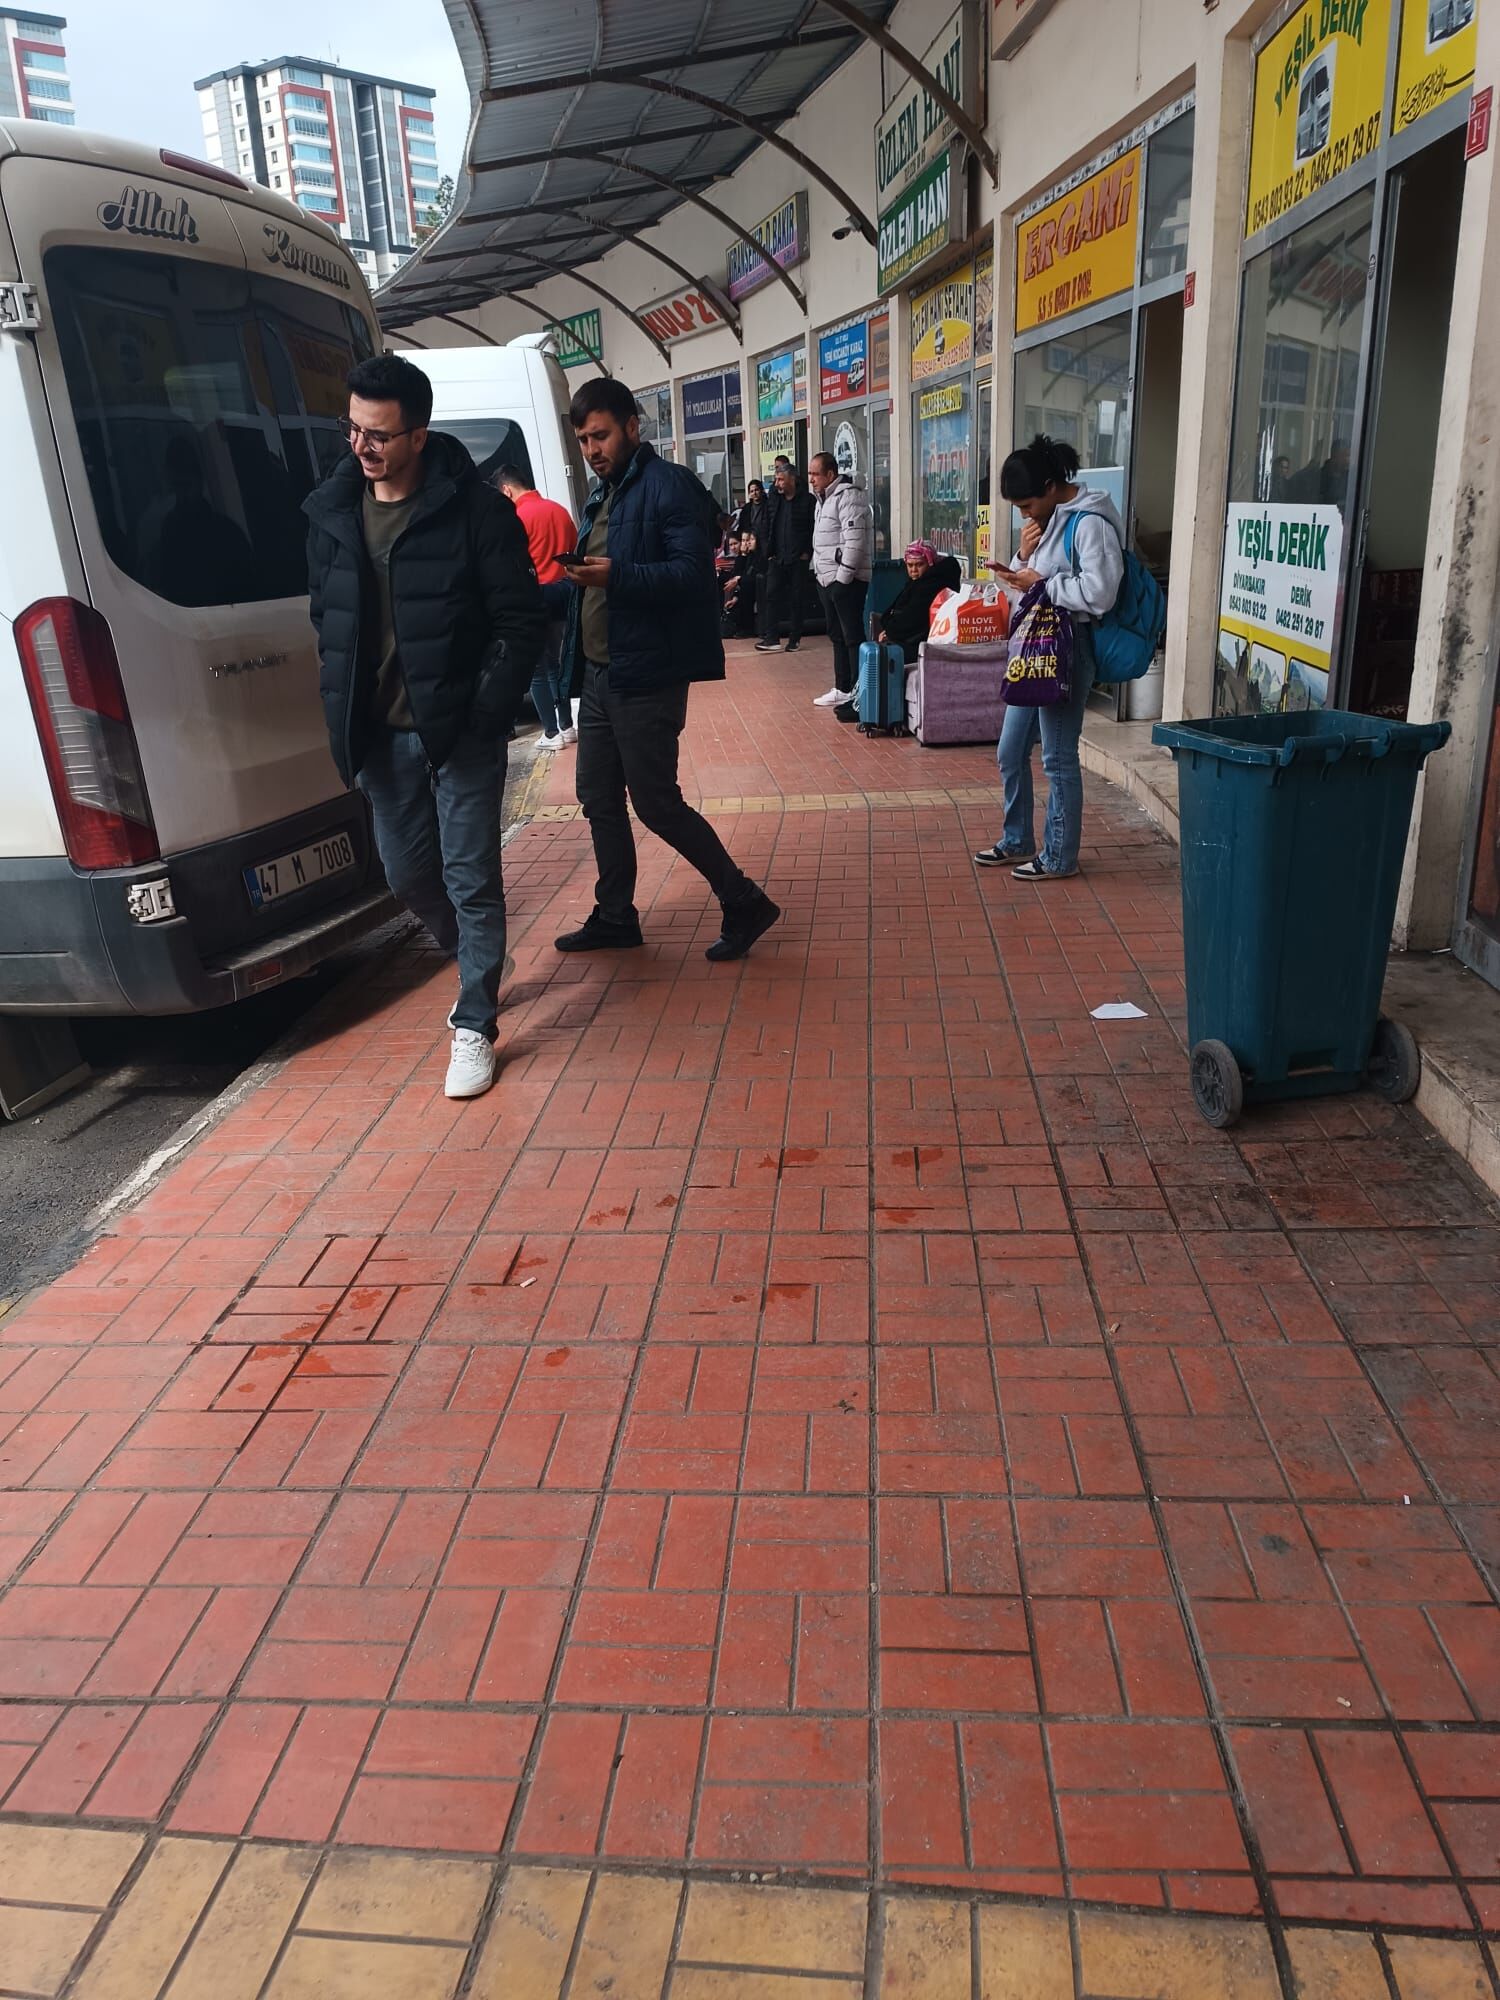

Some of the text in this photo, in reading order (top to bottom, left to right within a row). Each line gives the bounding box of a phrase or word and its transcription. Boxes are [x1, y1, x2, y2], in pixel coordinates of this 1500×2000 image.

[1274, 13, 1316, 118] YEŞİL
[878, 94, 918, 193] ÖZLEM
[1252, 196, 1268, 233] 0543
[1269, 183, 1284, 221] 803
[1283, 175, 1295, 209] 93
[1294, 167, 1306, 202] 22
[1333, 134, 1350, 179] 251
[1351, 123, 1365, 165] 29
[1366, 110, 1381, 155] 87
[97, 185, 351, 290] Allah Korusun
[879, 200, 915, 272] ÖZLEM
[1023, 156, 1137, 284] ERGANİ
[546, 312, 600, 357] RGANİ
[1237, 510, 1330, 571] YEŞİL DERİK
[1233, 569, 1266, 596] DİYARBAKIR
[1290, 584, 1313, 609] DERİK
[960, 616, 993, 625] IN LOVE
[960, 626, 998, 634] WITH MY
[1259, 604, 1267, 621] 22
[1275, 608, 1325, 640] 0482 251 29 87
[1027, 667, 1057, 679] ATIK
[260, 861, 280, 897] 47
[312, 835, 351, 876] 7008
